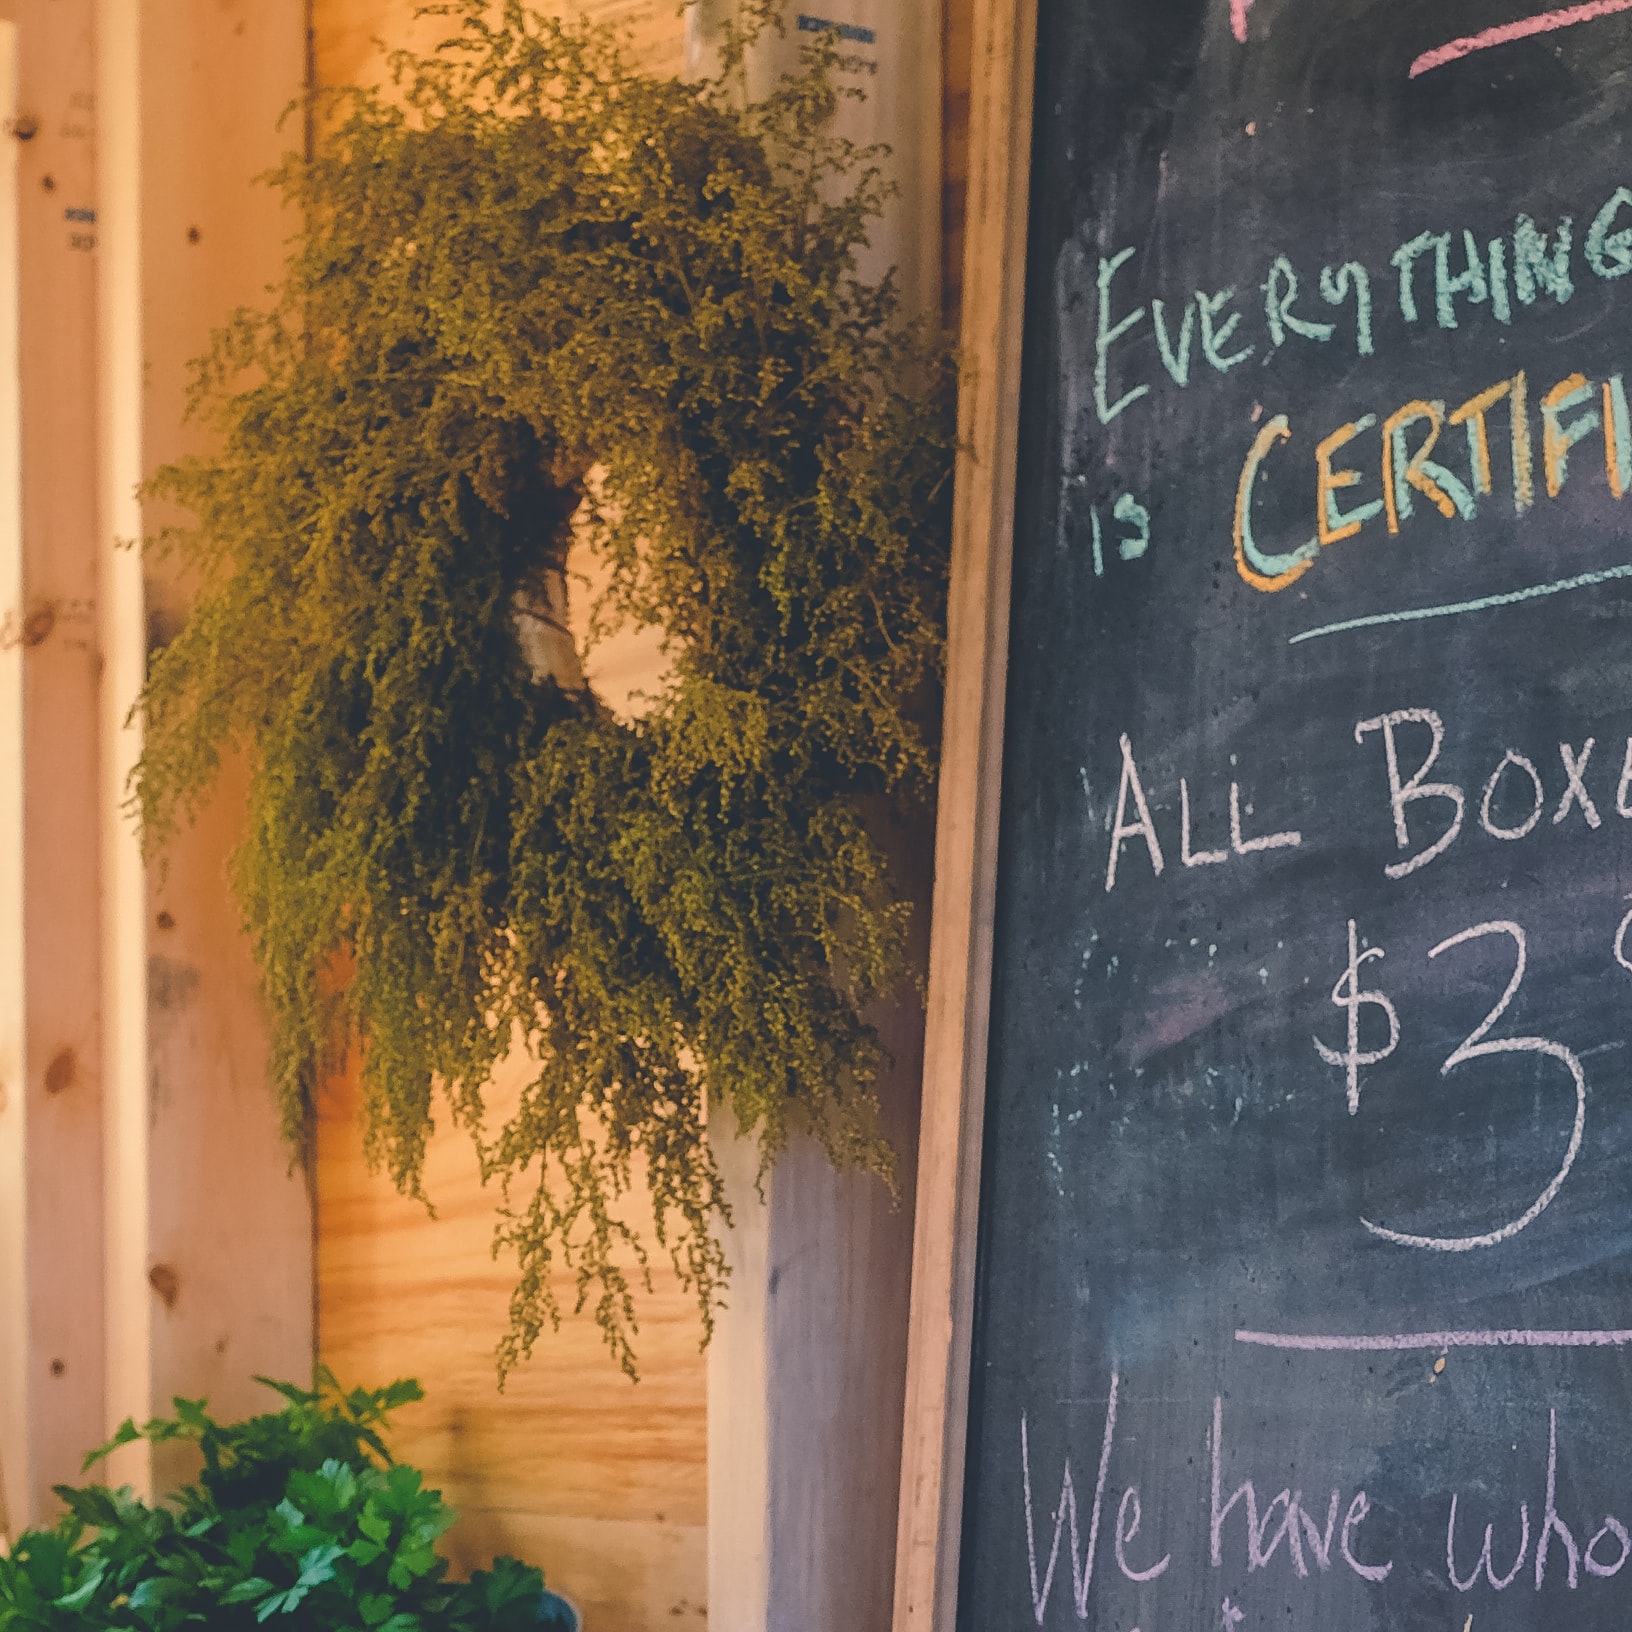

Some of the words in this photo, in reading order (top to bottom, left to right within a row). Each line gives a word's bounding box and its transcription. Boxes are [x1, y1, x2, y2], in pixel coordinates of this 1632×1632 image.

[1103, 731, 1303, 893] ALL
[1020, 1370, 1170, 1626] We
[1209, 1394, 1394, 1583] have
